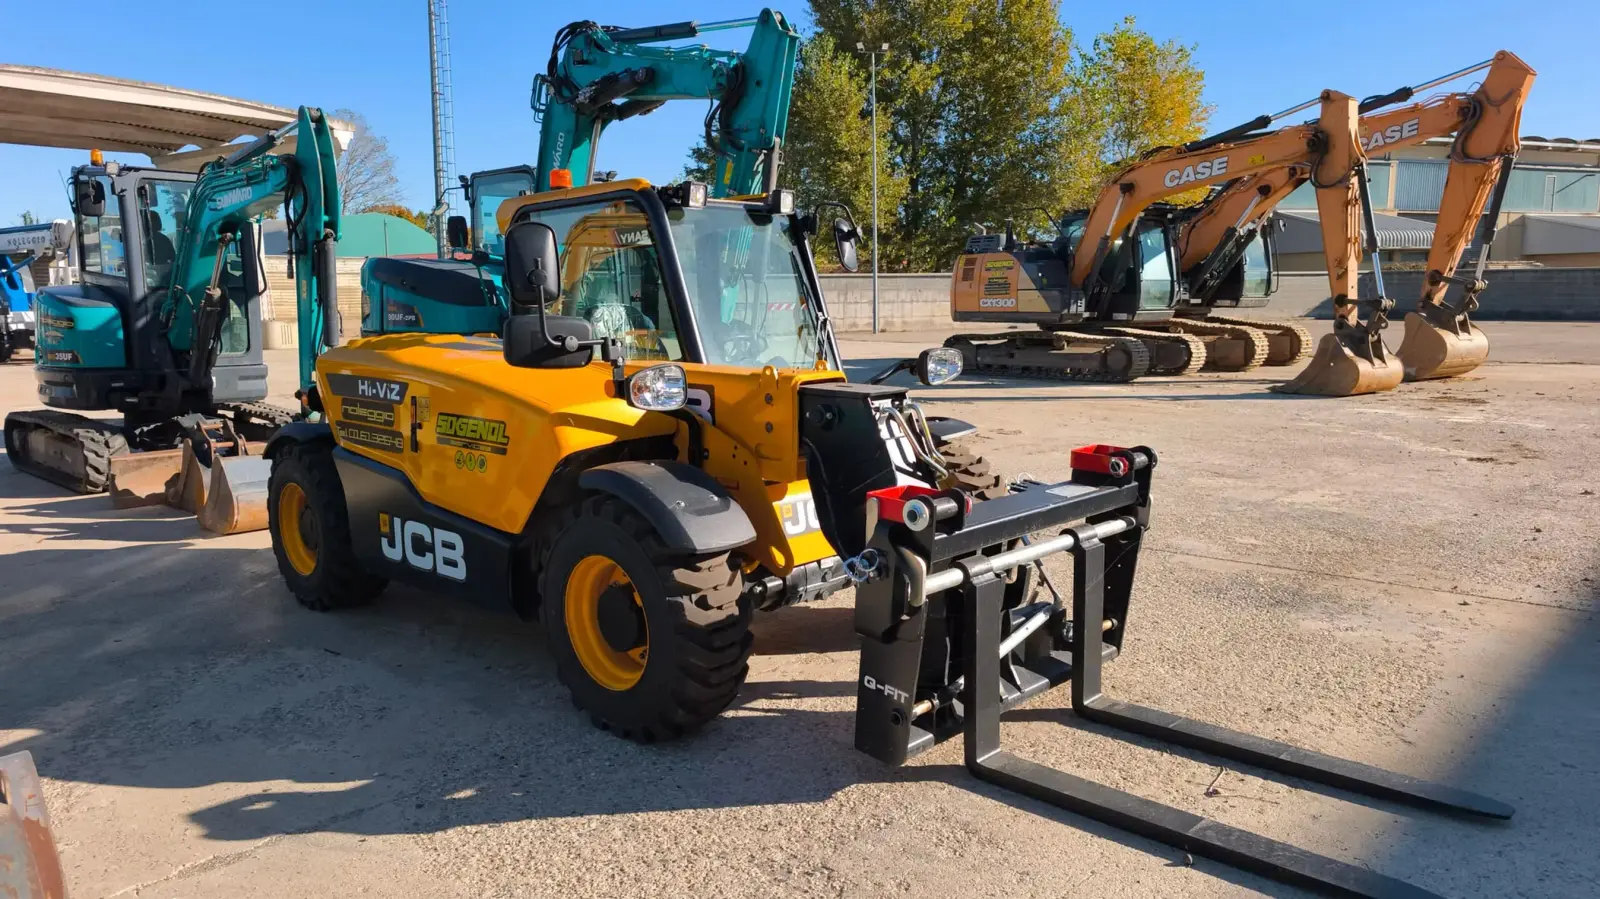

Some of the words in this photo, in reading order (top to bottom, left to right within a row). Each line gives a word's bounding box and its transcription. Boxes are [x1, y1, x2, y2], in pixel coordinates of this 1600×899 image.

[1164, 156, 1229, 188] CASE
[436, 414, 509, 445] SOGENOL
[380, 515, 467, 581] JCB
[864, 675, 909, 703] Q-FIT
